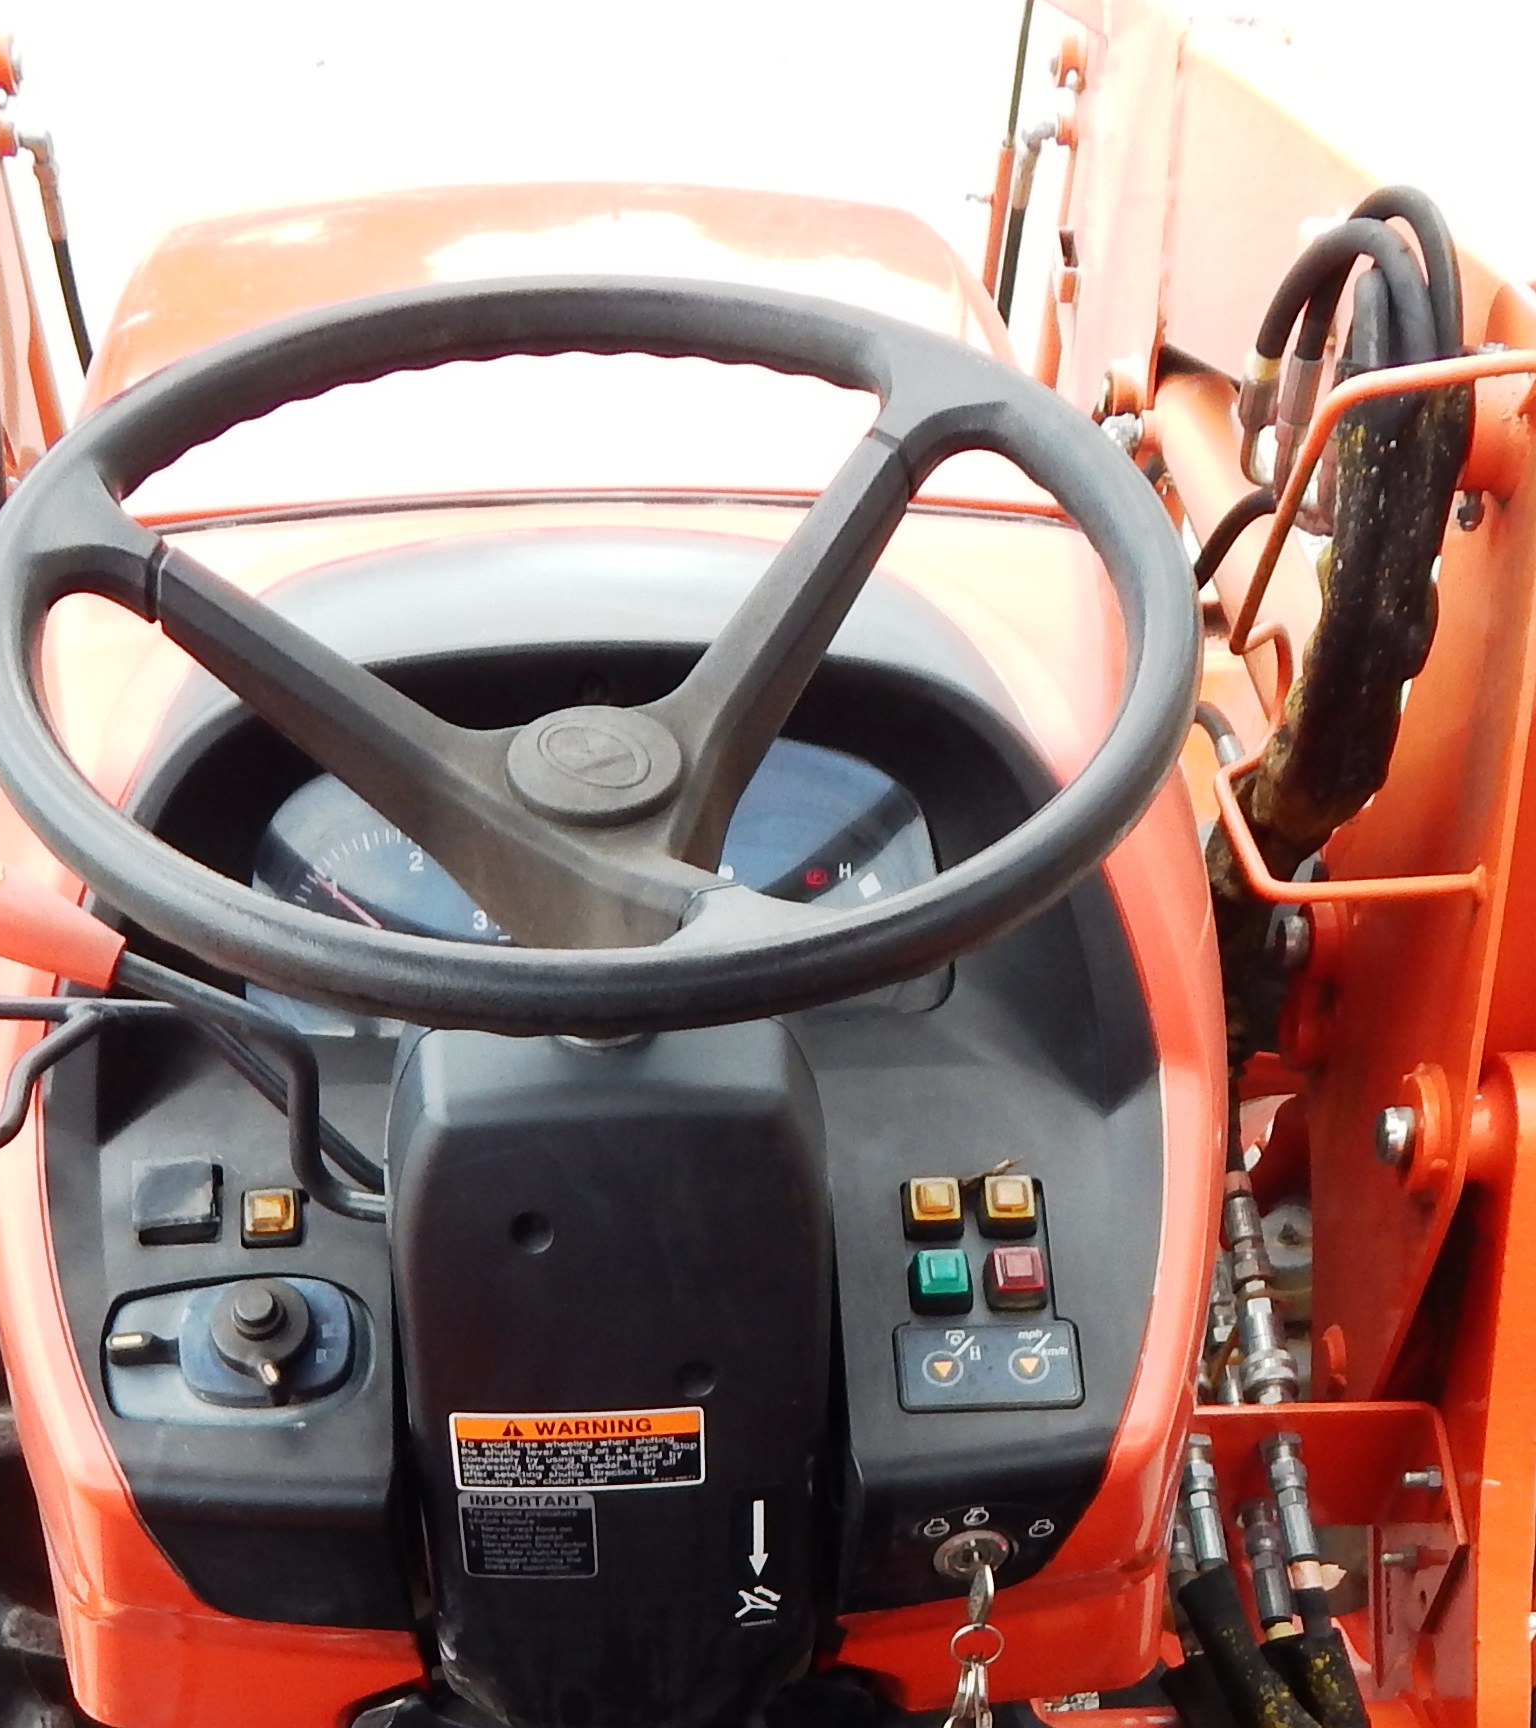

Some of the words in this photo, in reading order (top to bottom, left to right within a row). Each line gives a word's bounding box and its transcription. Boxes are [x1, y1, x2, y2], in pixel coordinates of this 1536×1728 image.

[408, 850, 425, 871] 2
[838, 862, 852, 879] H
[472, 910, 489, 931] 3
[1018, 1329, 1043, 1340] mph
[1040, 1345, 1069, 1356] km/h
[534, 1417, 652, 1437] WARNING
[469, 1495, 583, 1506] IMPORTANT
